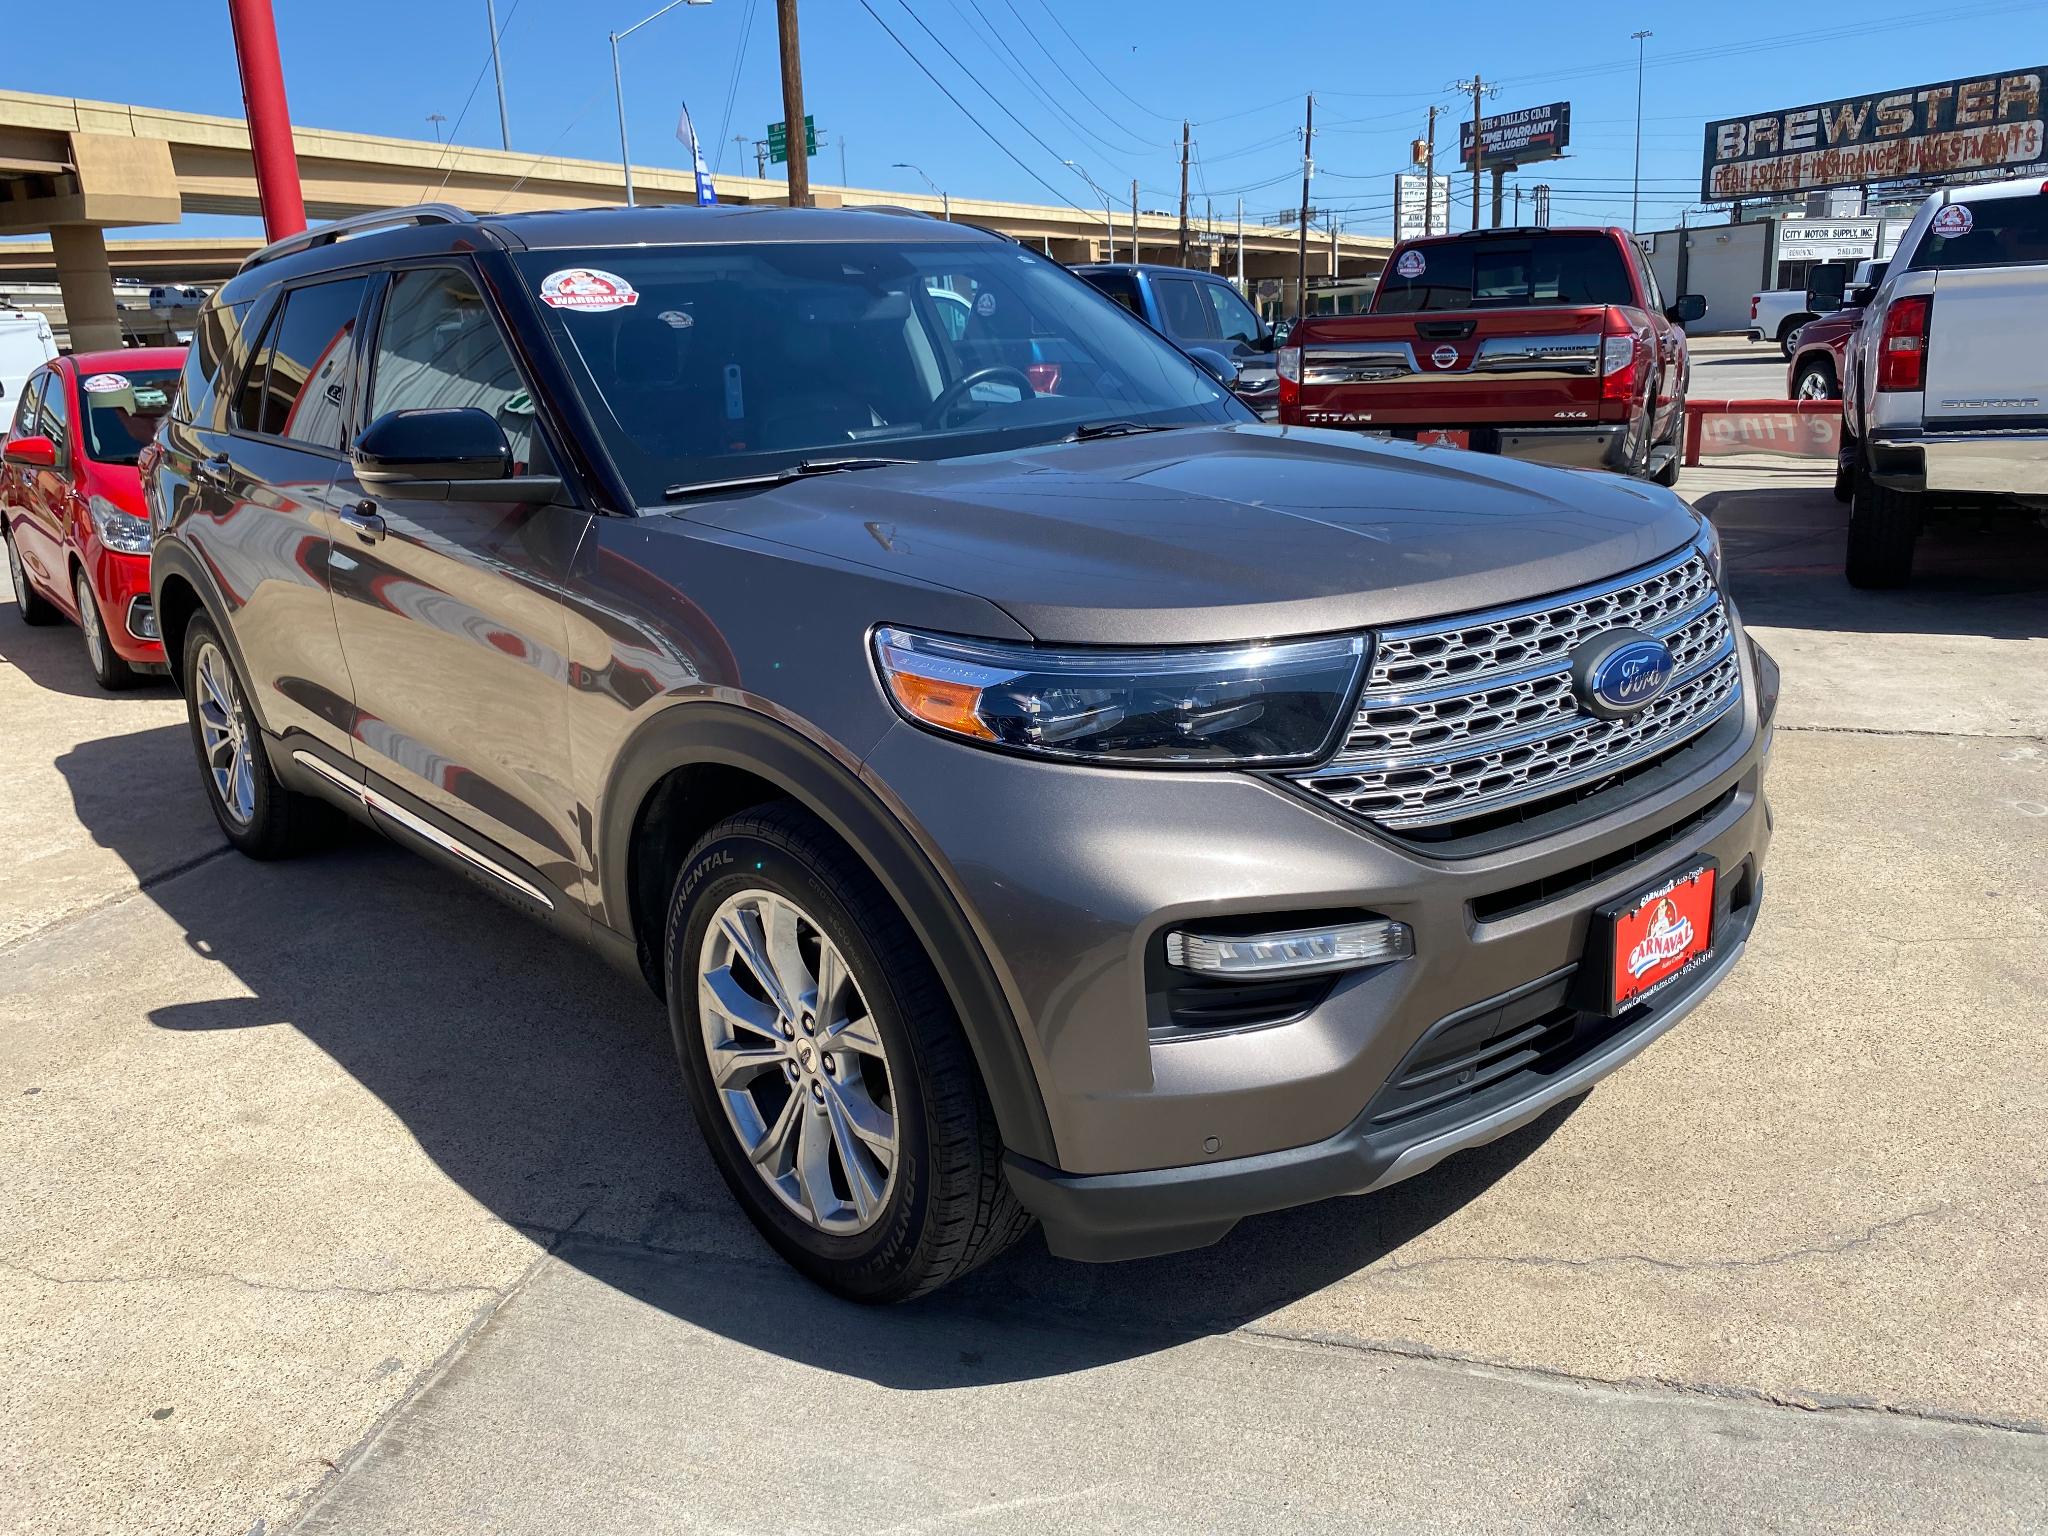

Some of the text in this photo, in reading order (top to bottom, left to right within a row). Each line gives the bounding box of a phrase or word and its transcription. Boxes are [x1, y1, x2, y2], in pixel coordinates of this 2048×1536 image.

[1500, 110, 1529, 127] DALLAS
[1530, 106, 1551, 121] CDJR
[1715, 73, 2041, 160] BREWSTER
[1463, 119, 1558, 149] LIFTIME WARRANTY
[1488, 136, 1530, 153] INCLUDED!
[1714, 164, 1747, 192] REAL
[1785, 228, 1873, 239] CITY MOTOR SUPPLY, INC.
[551, 296, 629, 305] WARRANTY
[1941, 397, 2040, 408] SIERRA
[1306, 412, 1372, 422] TITAN
[1619, 656, 1661, 697] Ford
[666, 849, 734, 994] CONTINENTAL
[1628, 921, 1694, 970] CARNAVAL
